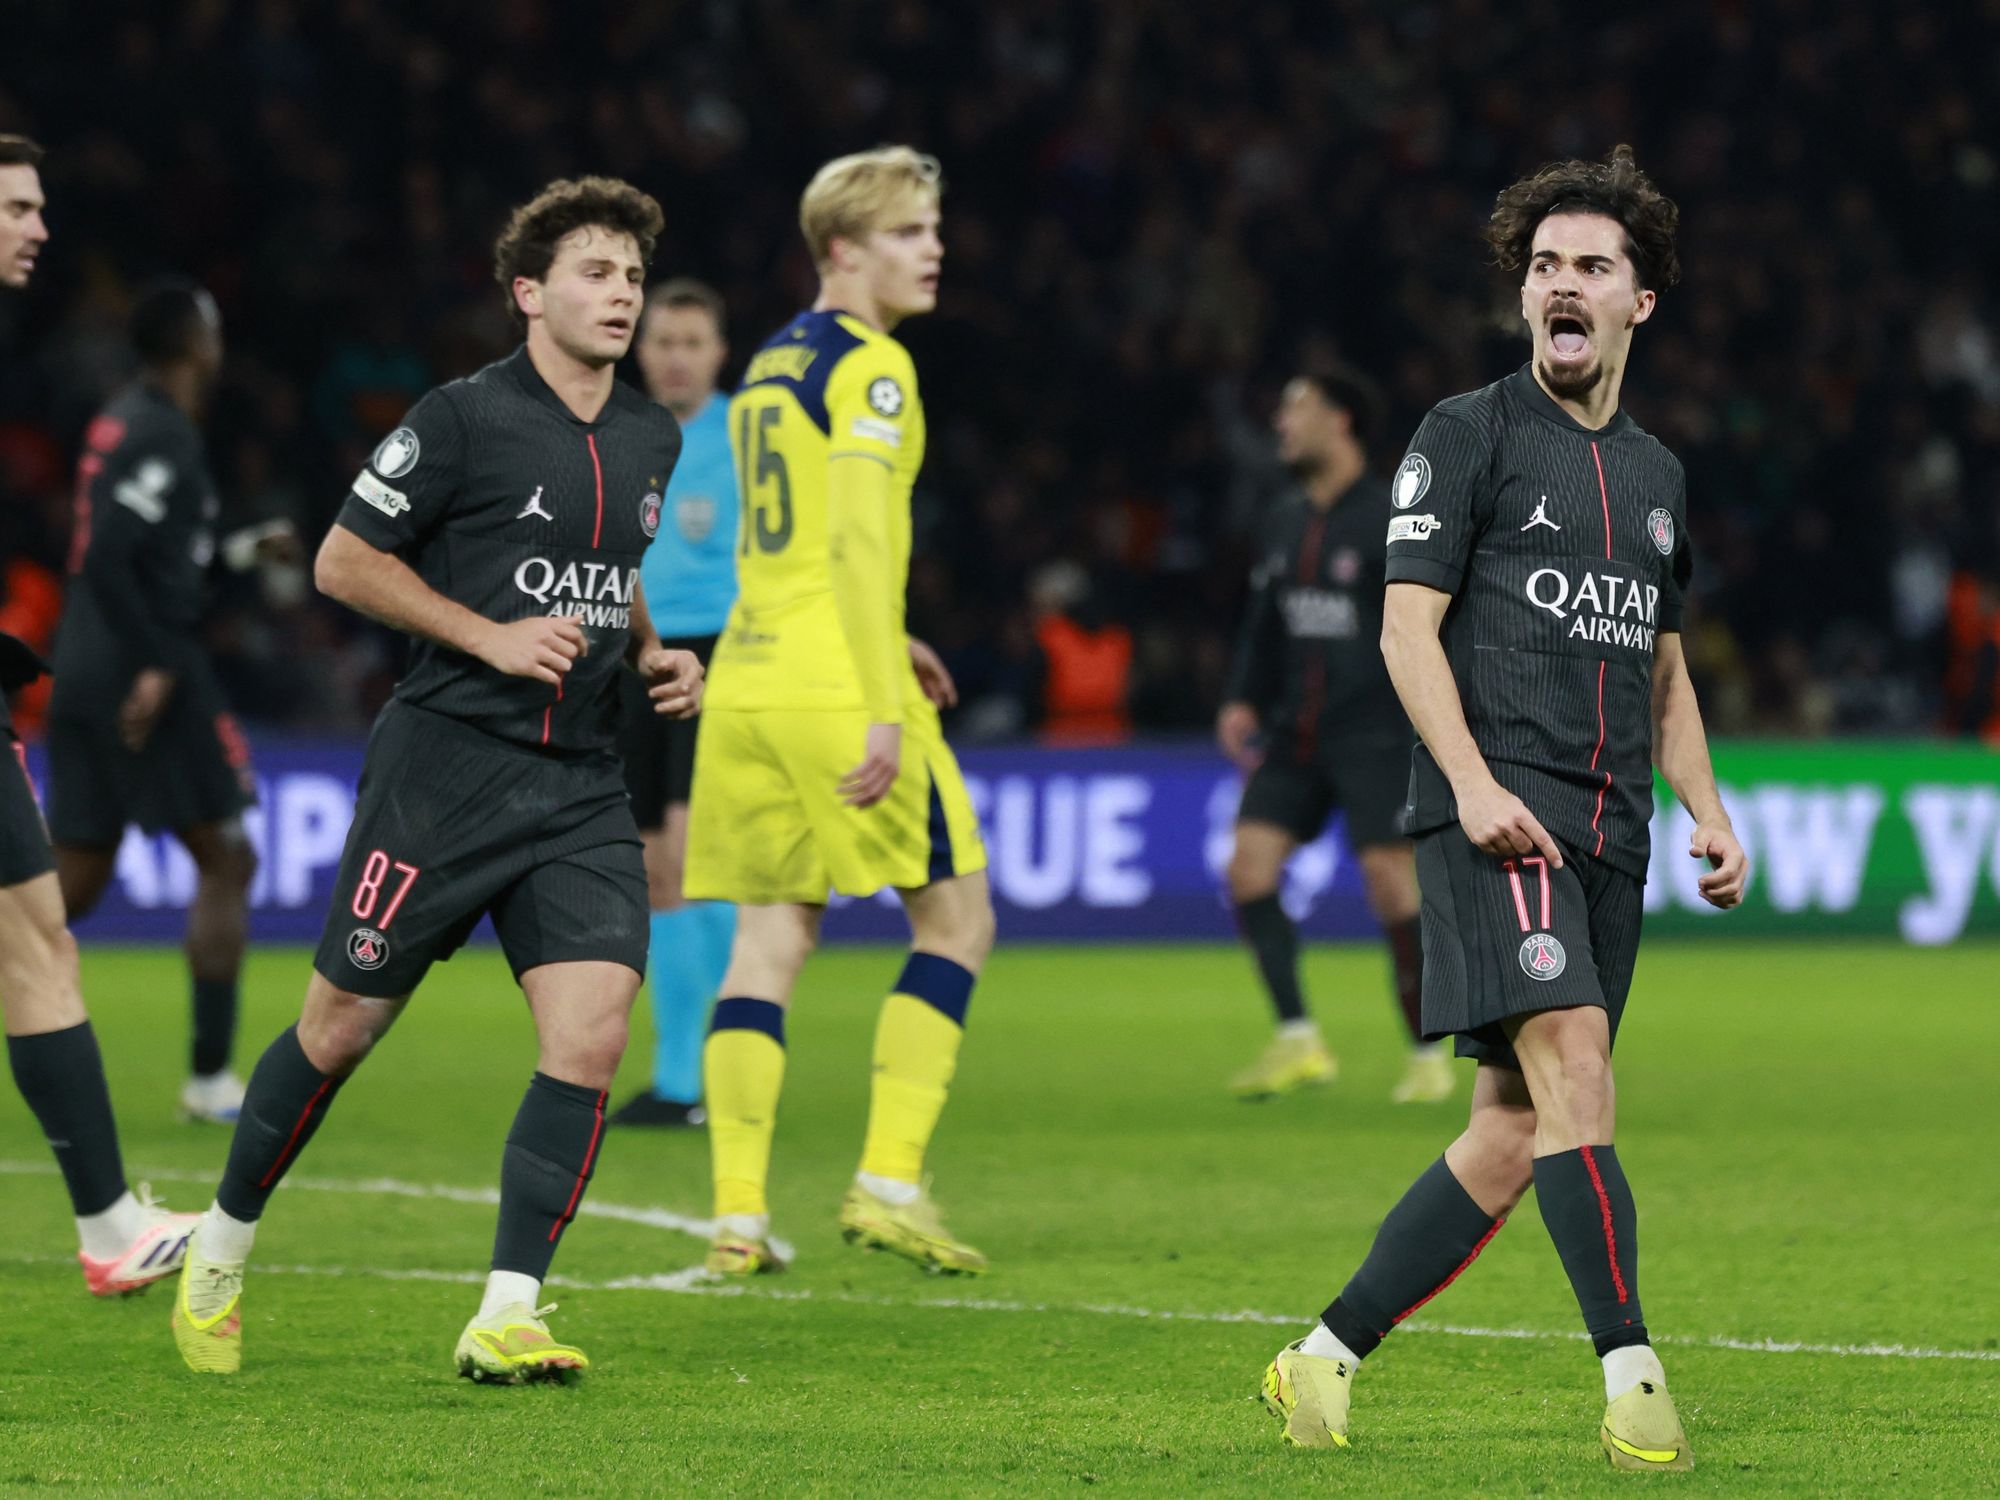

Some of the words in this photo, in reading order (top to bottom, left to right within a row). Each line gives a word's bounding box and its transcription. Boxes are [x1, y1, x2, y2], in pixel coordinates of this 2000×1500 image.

[741, 406, 793, 557] 15
[1412, 520, 1430, 533] 10
[1652, 510, 1671, 526] PARIS
[514, 557, 640, 604] QATAR
[1526, 568, 1659, 626] QATAR
[1568, 614, 1655, 653] AIRWAYS
[352, 849, 420, 930] 87
[1502, 855, 1551, 932] 17
[1525, 936, 1554, 950] PARIS
